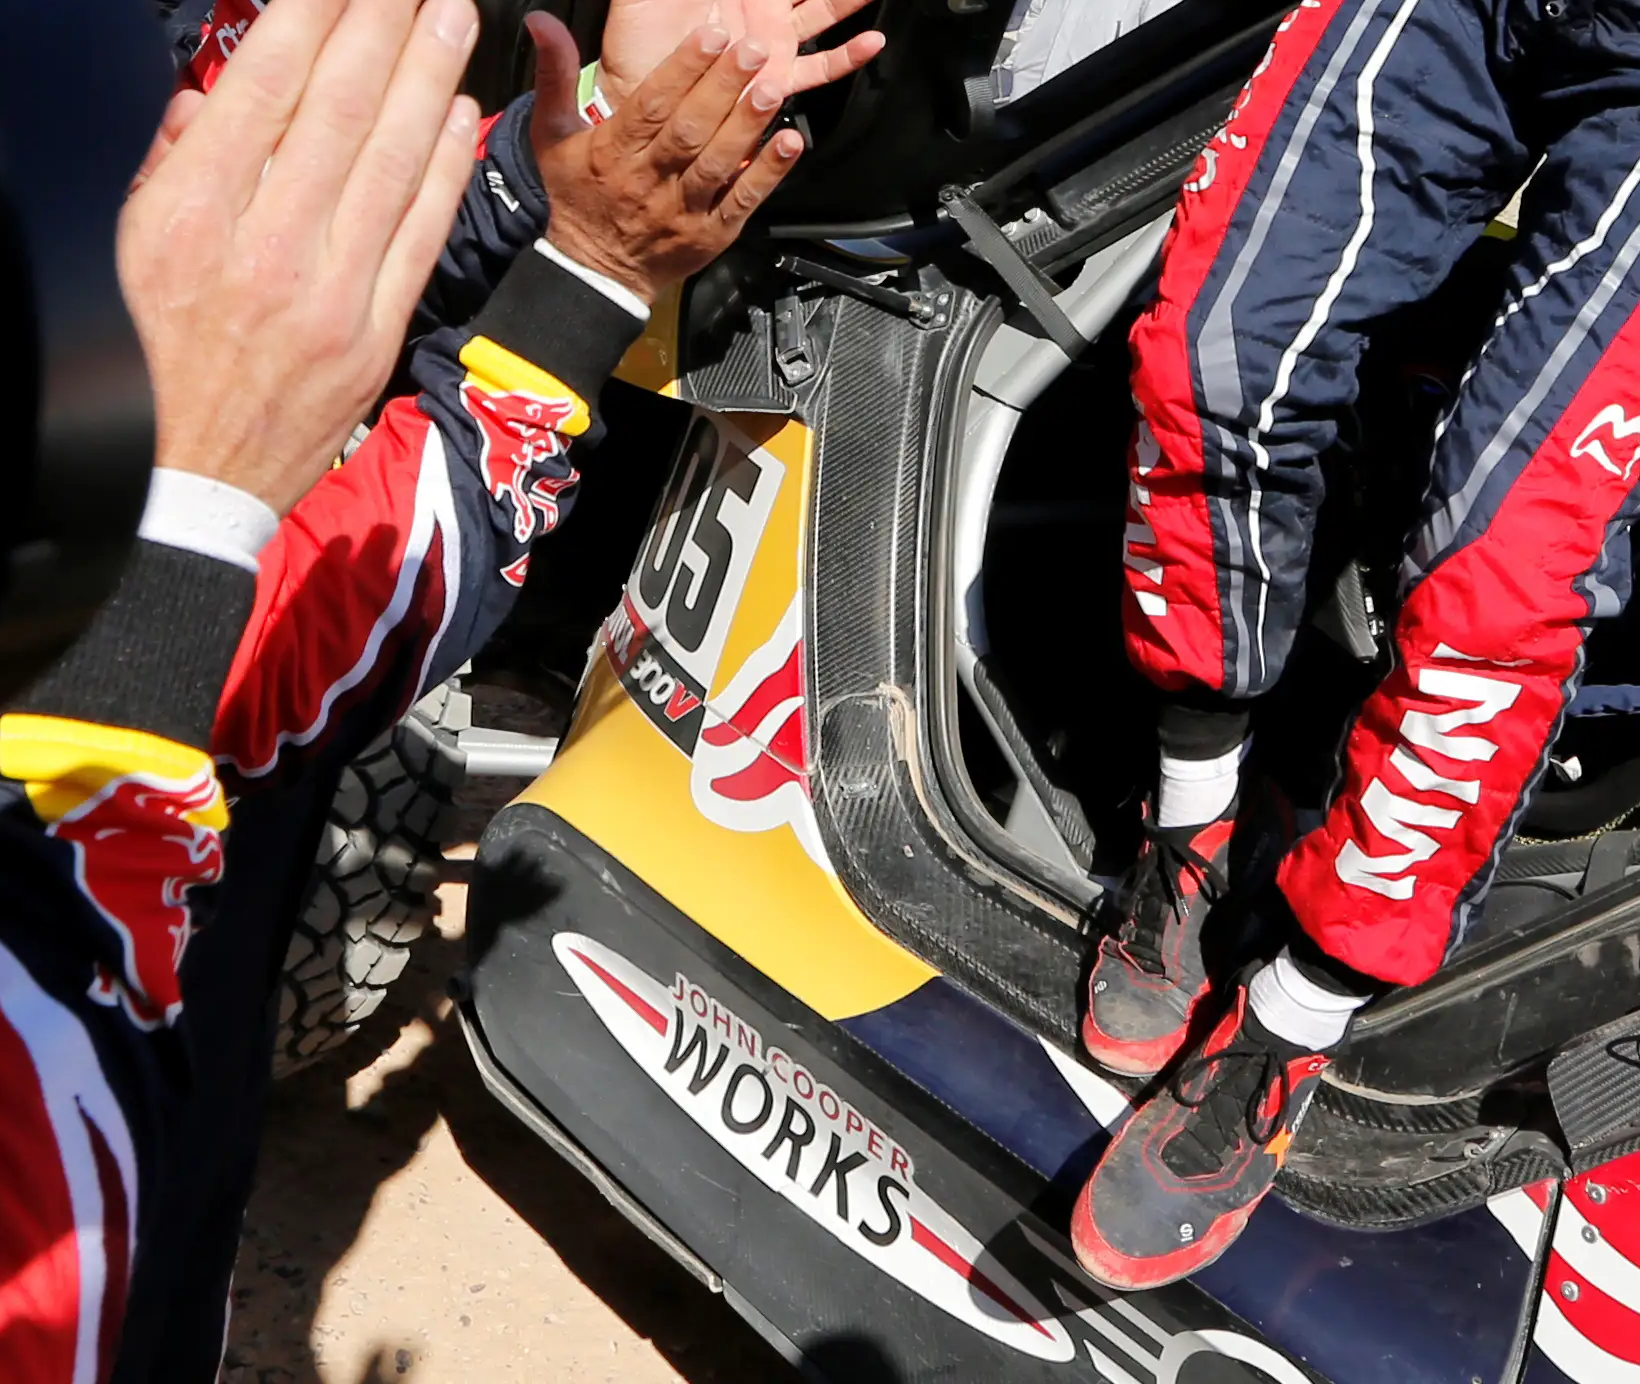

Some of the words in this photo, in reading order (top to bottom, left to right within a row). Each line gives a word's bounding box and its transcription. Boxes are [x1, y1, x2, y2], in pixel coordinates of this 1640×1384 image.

[629, 649, 702, 723] 300V
[664, 1006, 911, 1246] WORKS
[673, 978, 756, 1057] JOHN
[772, 1053, 911, 1182] COOPER
